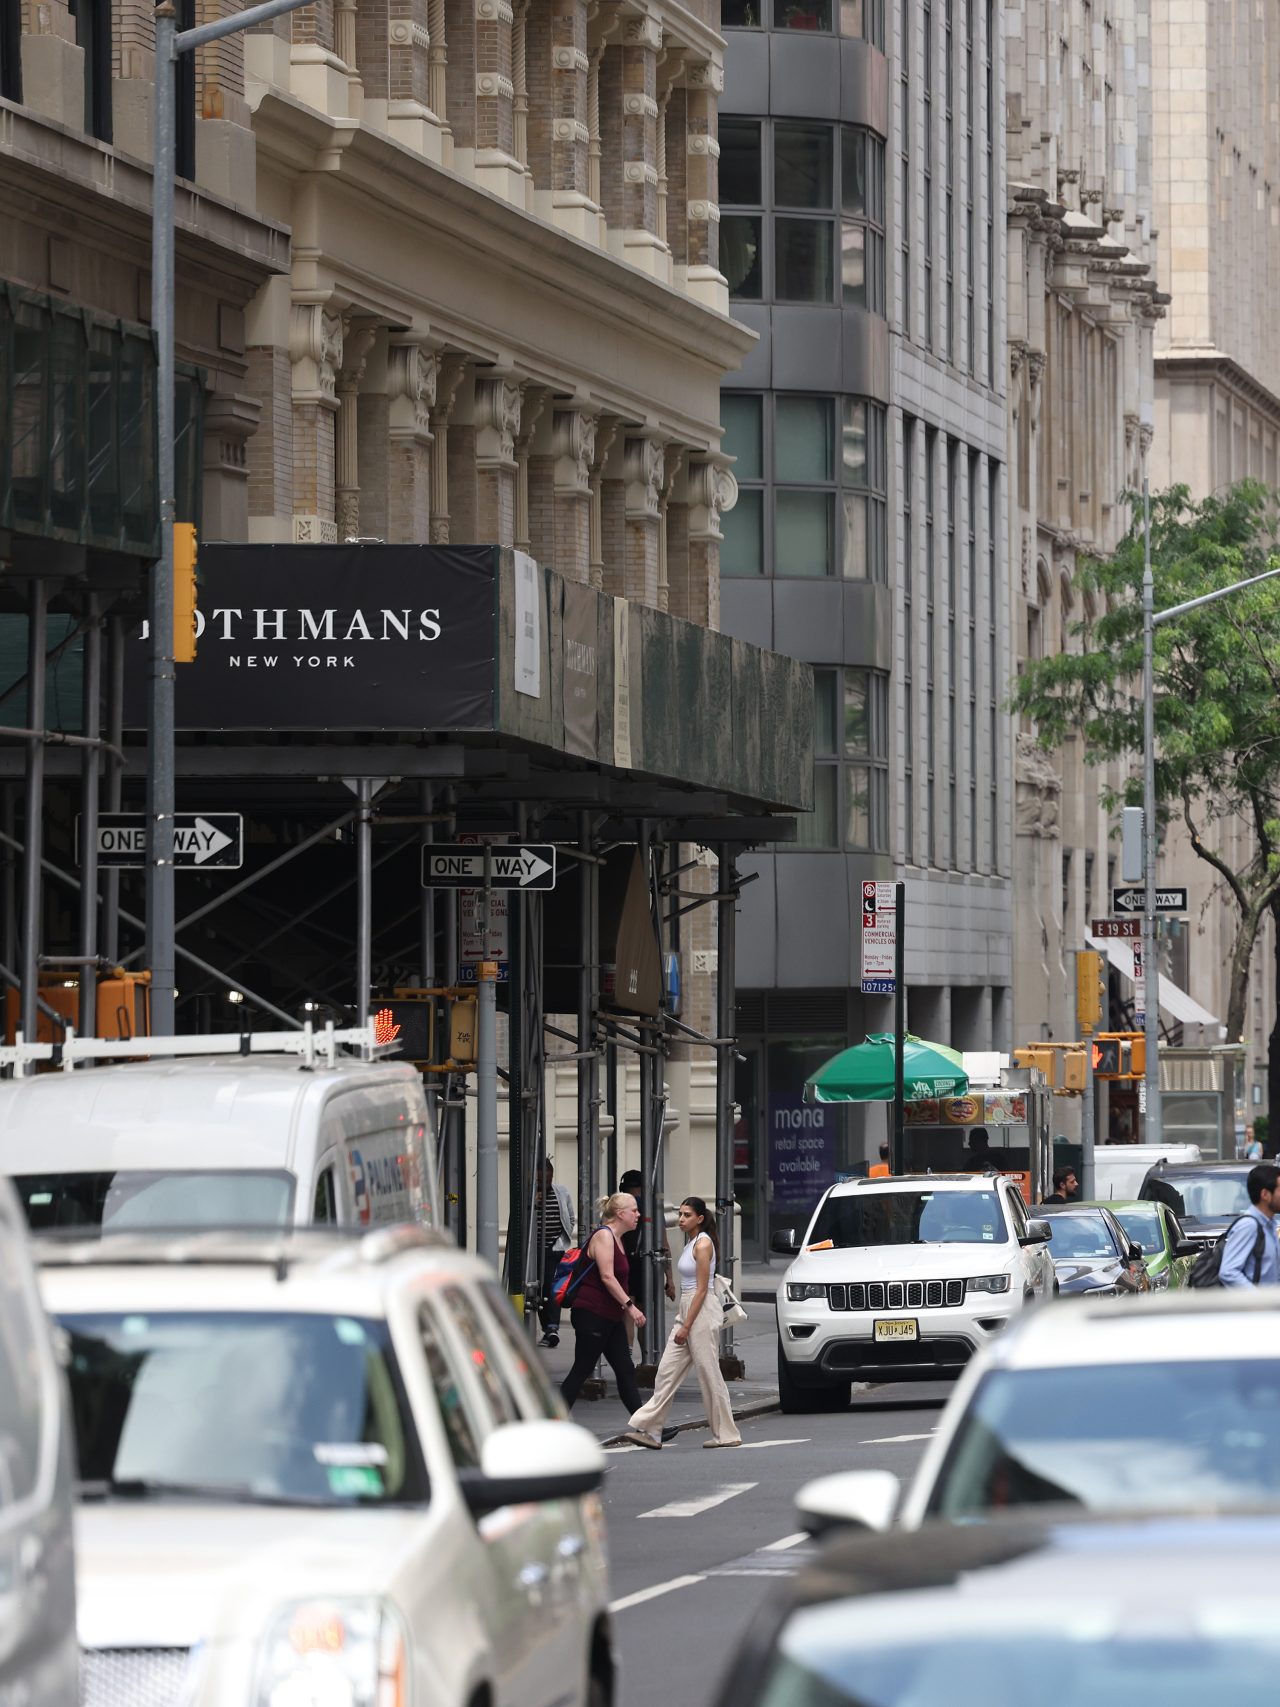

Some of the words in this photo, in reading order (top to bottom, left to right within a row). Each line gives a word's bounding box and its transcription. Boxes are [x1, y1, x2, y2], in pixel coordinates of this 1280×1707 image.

[138, 608, 442, 641] THMANS
[229, 655, 279, 668] NEW
[293, 655, 356, 668] YORK
[101, 830, 146, 851] ONE
[173, 831, 217, 851] WAY
[434, 857, 473, 875] ONE
[495, 858, 537, 875] WAY
[1123, 895, 1146, 905] ONE
[1155, 895, 1178, 905] WAY
[866, 915, 873, 927] 3
[1097, 924, 1104, 936] E
[1107, 923, 1119, 936] 19
[1123, 923, 1134, 936] St
[912, 1081, 931, 1091] VITA
[775, 1107, 825, 1129] mona
[775, 1135, 797, 1150] retail
[798, 1138, 825, 1153] space
[778, 1156, 821, 1173] available
[898, 1324, 914, 1336] J45
